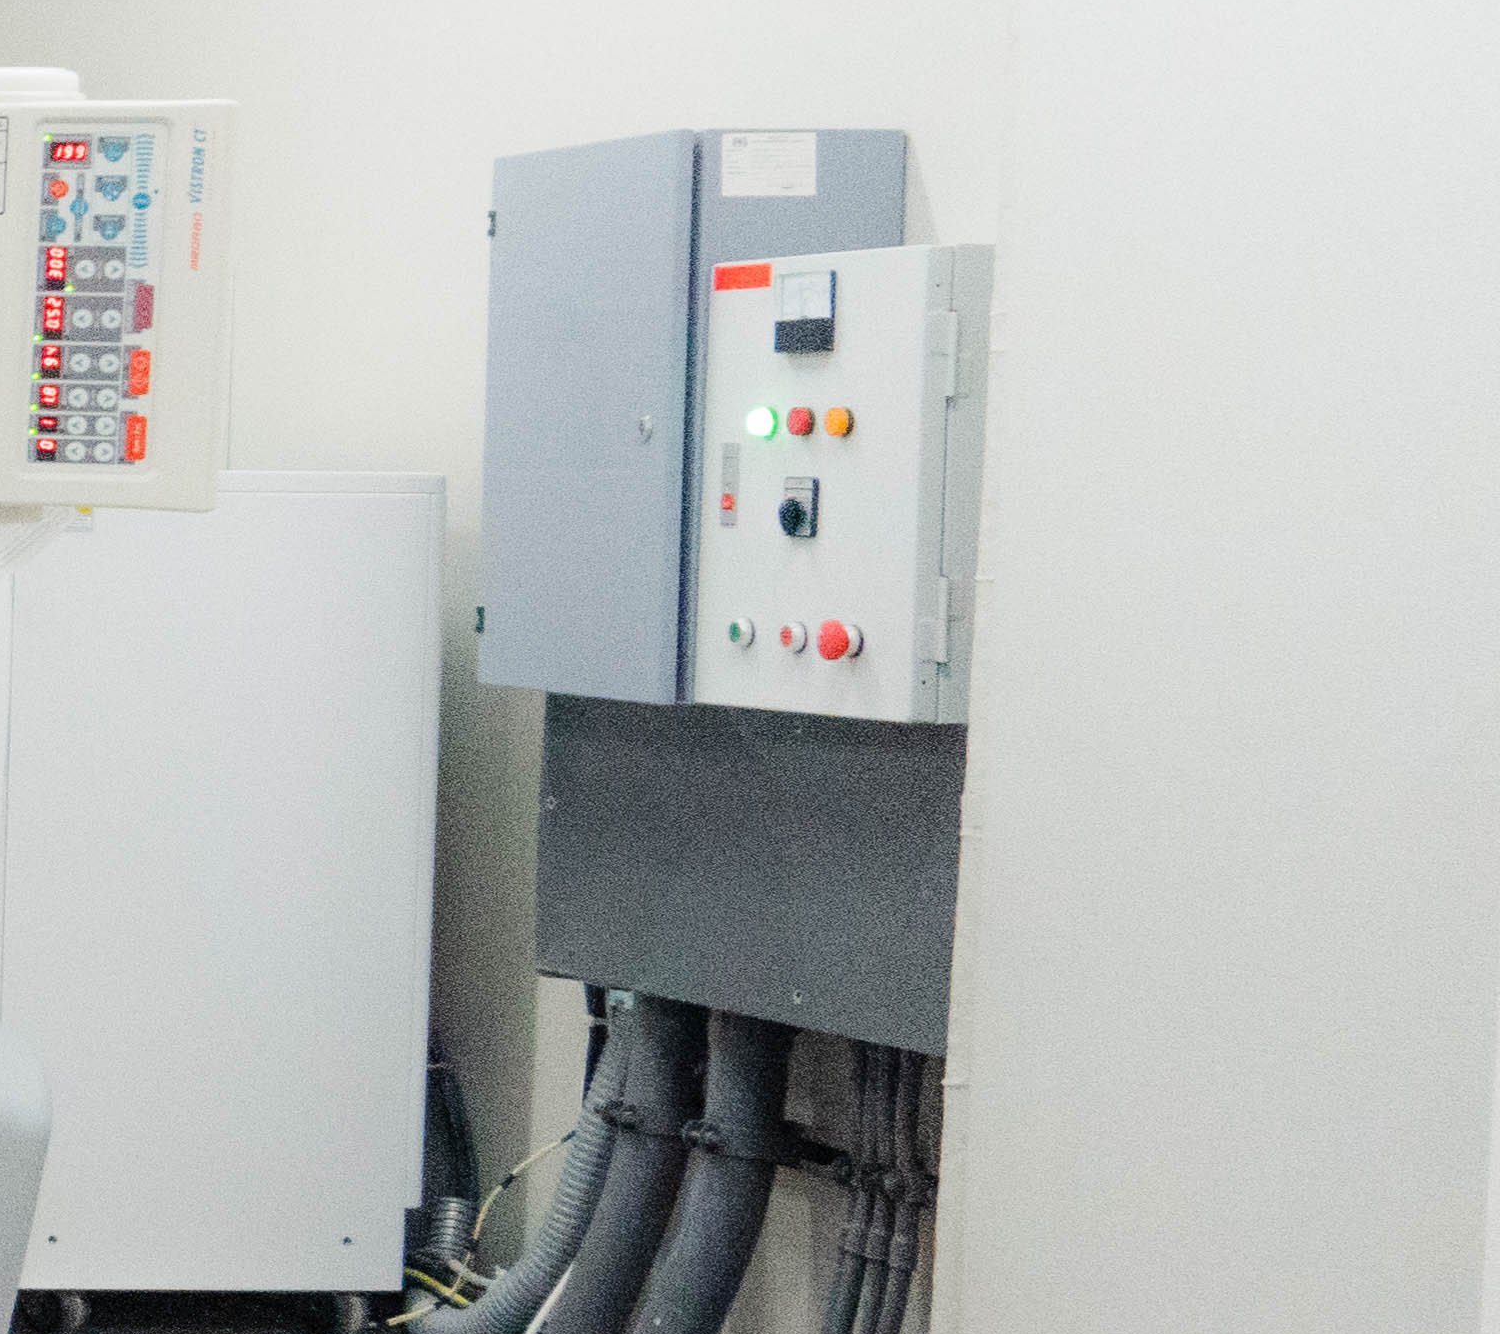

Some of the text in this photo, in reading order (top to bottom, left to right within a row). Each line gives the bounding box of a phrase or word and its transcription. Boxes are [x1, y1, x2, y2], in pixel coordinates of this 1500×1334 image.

[54, 143, 86, 160] 199
[188, 146, 205, 204] VISTRON
[48, 247, 66, 280] 300
